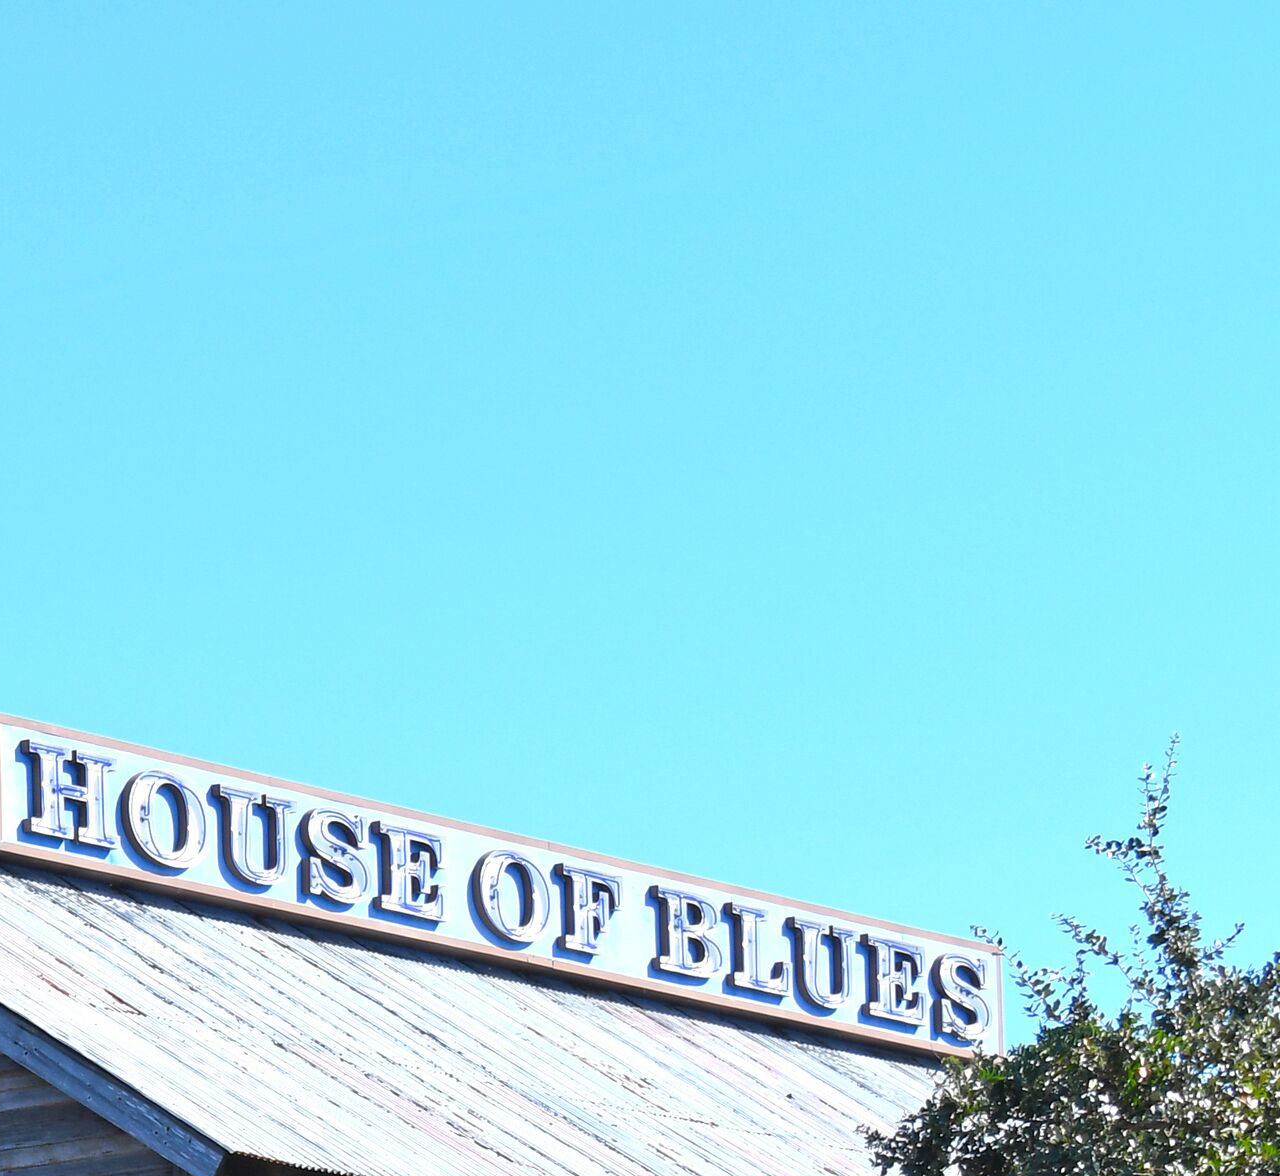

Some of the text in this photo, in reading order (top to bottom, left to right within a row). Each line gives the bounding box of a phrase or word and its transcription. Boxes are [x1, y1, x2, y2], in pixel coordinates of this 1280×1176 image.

[20, 738, 992, 1042] HOUSE OF BLUES
